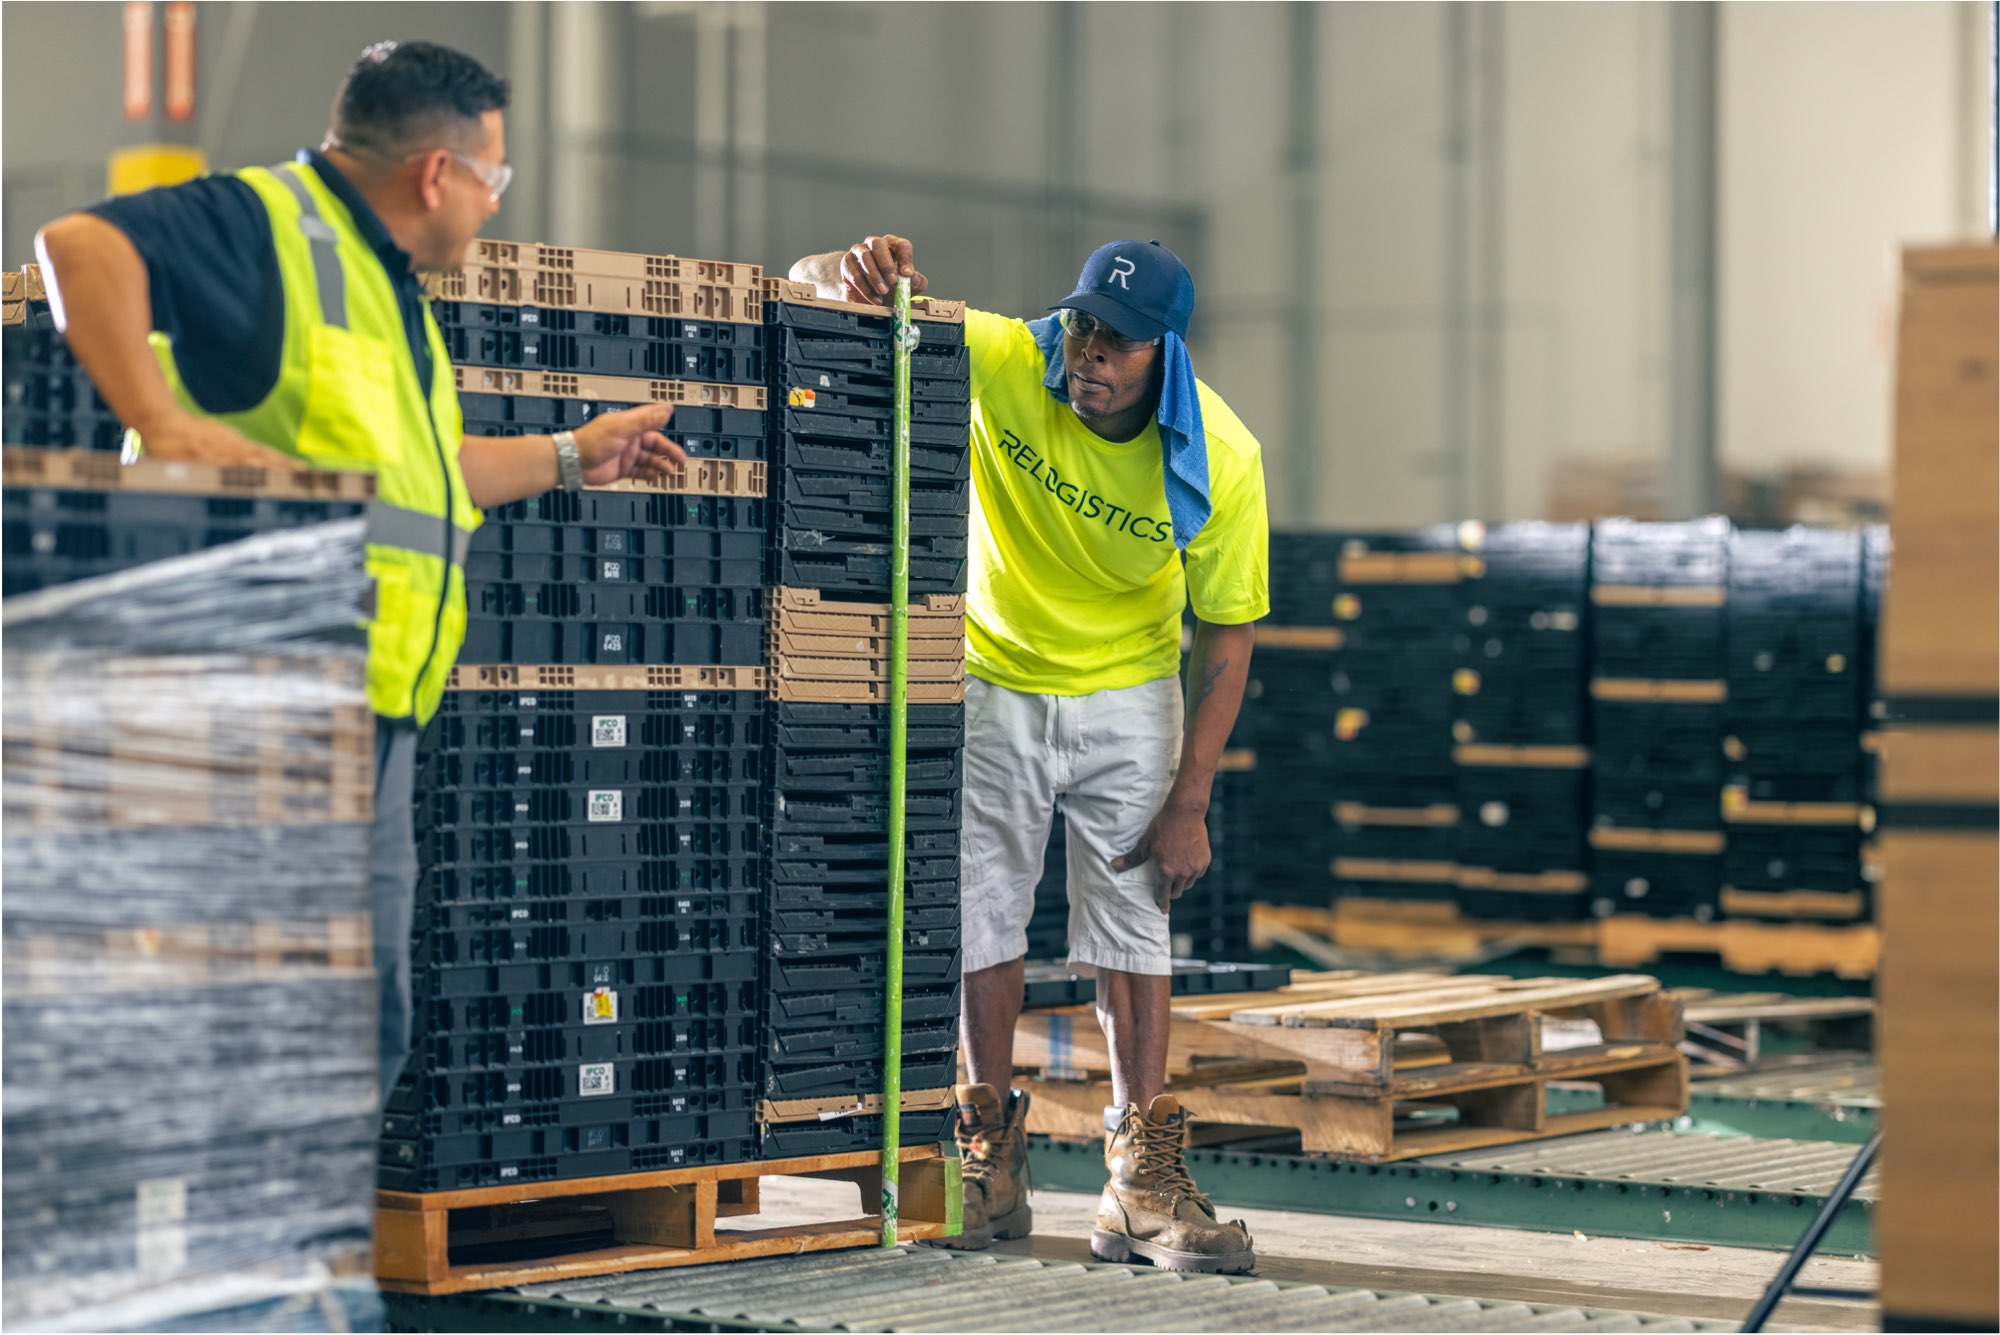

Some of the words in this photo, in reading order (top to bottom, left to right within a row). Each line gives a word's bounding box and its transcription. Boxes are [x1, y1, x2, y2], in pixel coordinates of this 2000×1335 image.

[1107, 255, 1136, 291] R
[521, 313, 538, 322] IFCO
[998, 428, 1173, 543] RELOGISTICS
[604, 562, 620, 570] IFCO
[604, 635, 621, 643] IFCO
[519, 697, 537, 706] IFCO
[598, 719, 618, 728] IFCO
[595, 793, 614, 802] IFCO
[511, 909, 529, 918] IFCO
[586, 1067, 606, 1076] IFCO
[503, 1114, 521, 1124] IFCO
[500, 1167, 518, 1177] IFCO
